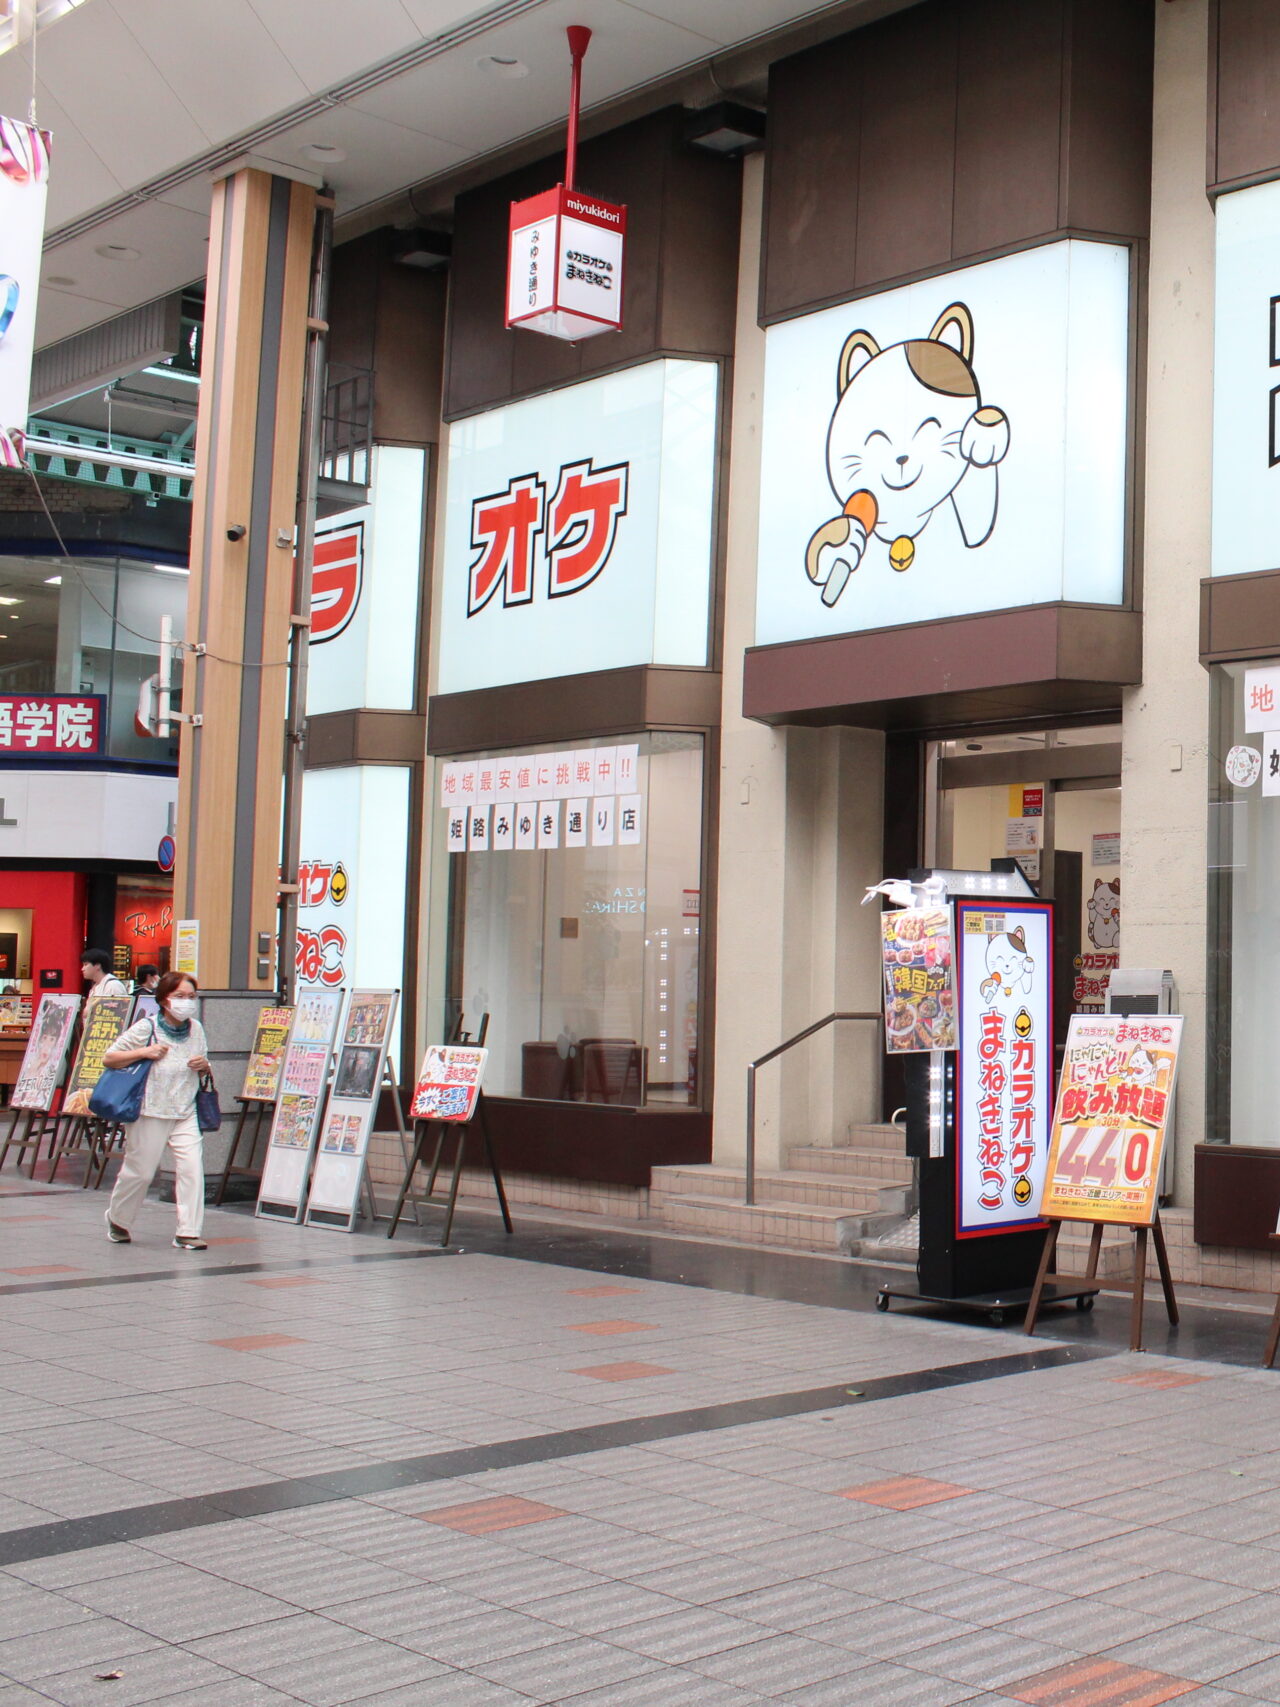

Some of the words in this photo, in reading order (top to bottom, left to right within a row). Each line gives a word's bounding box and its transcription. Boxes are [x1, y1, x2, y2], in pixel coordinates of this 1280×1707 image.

[567, 199, 620, 224] miyukidori
[528, 230, 540, 307] みゆき通り
[573, 251, 606, 270] カラオケ
[566, 264, 612, 290] まねきねこ
[467, 458, 629, 618] オケ
[444, 758, 631, 794] 地域最安値に挑戦中!!
[451, 809, 636, 840] 姫路みゆき通り店
[125, 906, 173, 937] Ray-B
[1082, 1027, 1109, 1036] カラオケ
[1116, 1024, 1173, 1043] まねきねこ
[977, 1007, 1007, 1210] まねきねこ
[1010, 1038, 1035, 1178] カラオケ
[1061, 1082, 1168, 1126] 飲み放題
[1101, 1116, 1120, 1127] 30分
